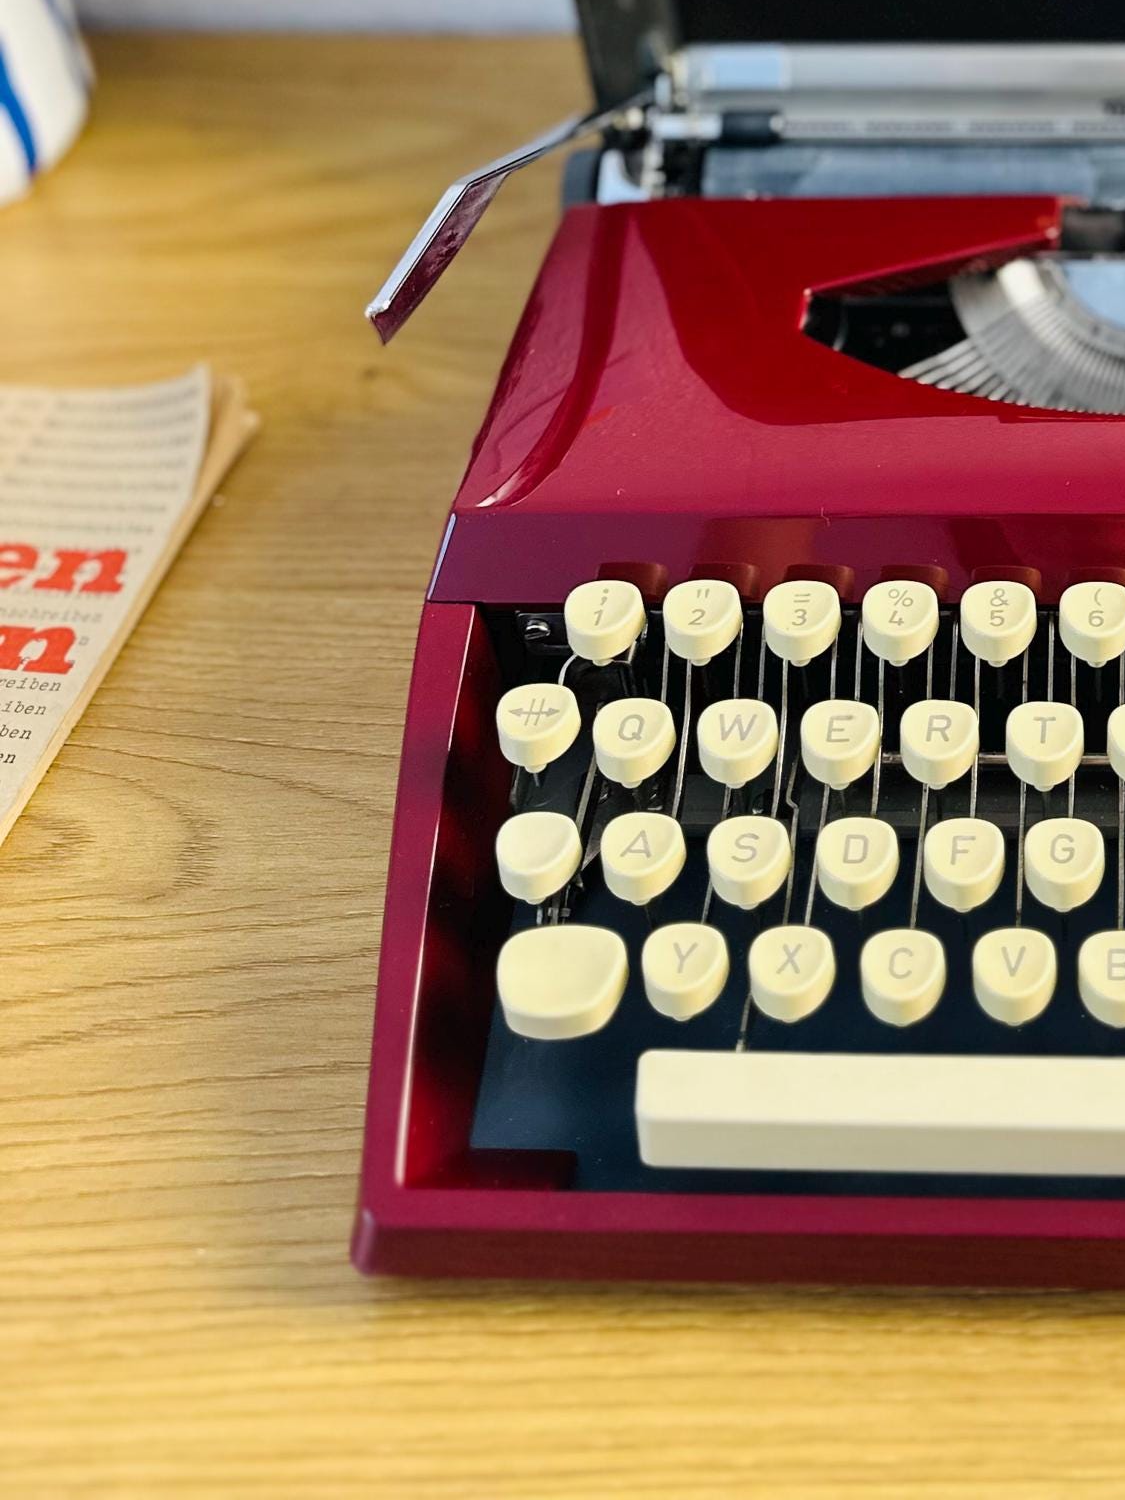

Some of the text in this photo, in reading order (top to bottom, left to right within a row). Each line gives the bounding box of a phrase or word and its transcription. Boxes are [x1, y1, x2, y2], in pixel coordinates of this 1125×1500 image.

[888, 588, 914, 608] %
[989, 588, 1009, 607] &
[1093, 588, 1102, 607] (
[594, 609, 603, 627] 1
[688, 609, 705, 626] 2
[791, 609, 808, 627] 3
[889, 610, 905, 627] 4
[989, 610, 1006, 627] 5
[1088, 610, 1105, 628] 6
[618, 714, 647, 742] Q
[719, 713, 759, 743] W
[826, 714, 856, 744] E
[926, 715, 954, 743] R
[1033, 716, 1056, 744] T
[620, 830, 654, 860] A
[731, 833, 761, 864] S
[842, 834, 870, 865] D
[950, 835, 977, 866] F
[1050, 834, 1075, 864] G
[673, 942, 699, 974] Y
[776, 943, 804, 975] X
[888, 947, 915, 980] C
[1001, 946, 1026, 977] V
